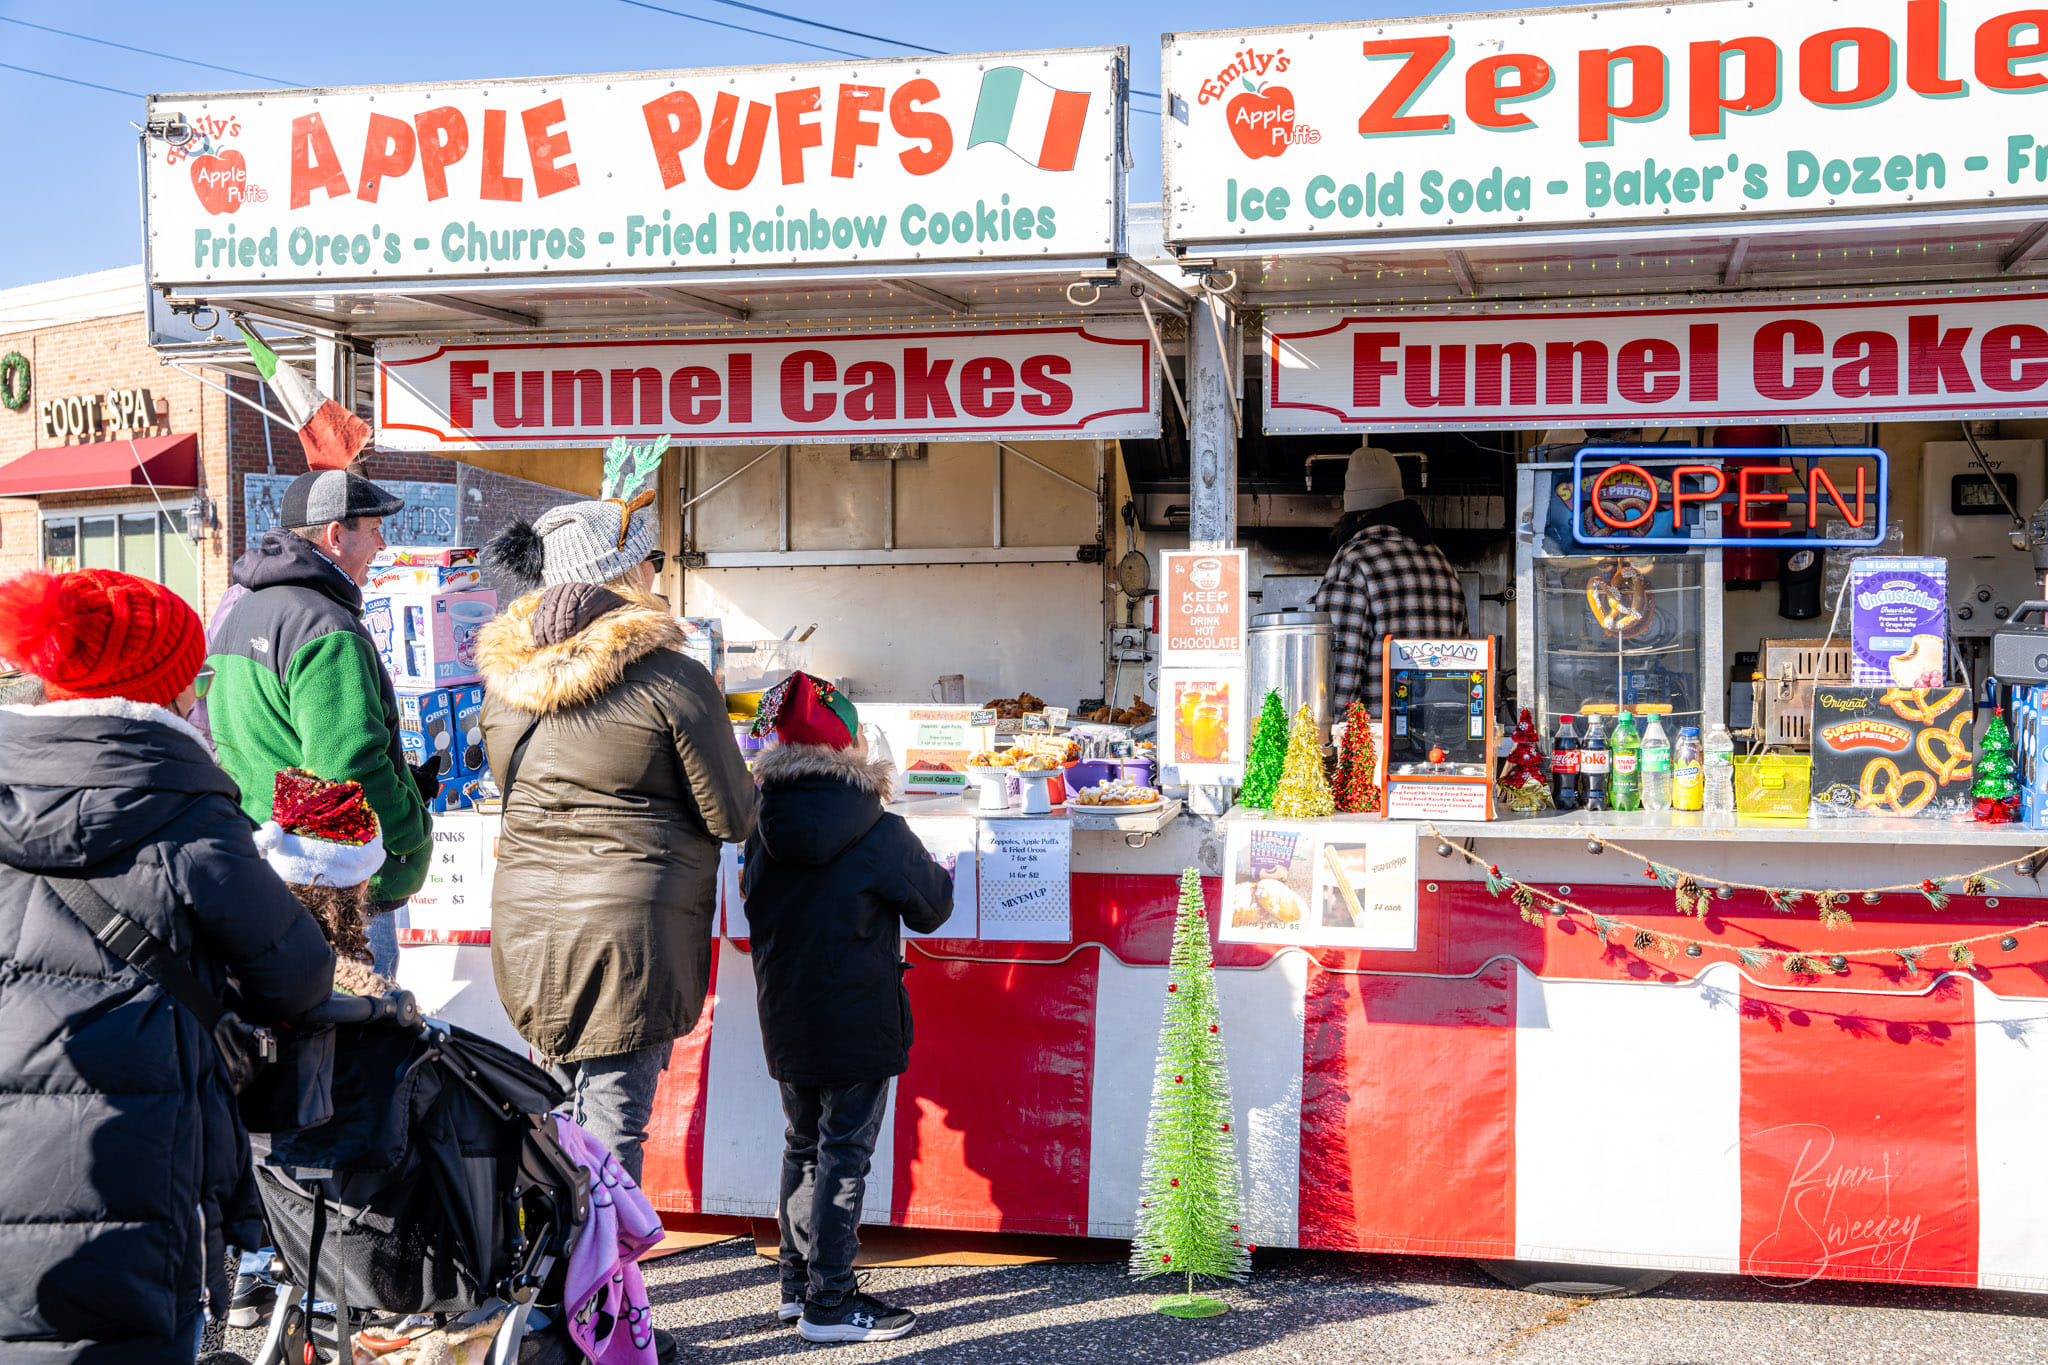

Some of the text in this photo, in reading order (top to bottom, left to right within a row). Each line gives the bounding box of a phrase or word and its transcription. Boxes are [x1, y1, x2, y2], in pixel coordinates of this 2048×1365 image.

[1198, 48, 1291, 106] Emily's
[1235, 106, 1295, 129] Apple
[1272, 125, 1321, 146] Puffs
[290, 78, 954, 210] APPLE PUFFS
[198, 166, 247, 188] Apple
[228, 184, 268, 203] Puffs
[1227, 178, 1291, 222] Ice
[1305, 171, 1404, 219] Cold
[1420, 167, 1531, 215] Soda
[1585, 153, 1768, 208] Baker's
[1787, 150, 1946, 197] Dozen
[194, 223, 278, 269] Fried
[288, 224, 401, 266] Oreo's
[442, 222, 586, 263] Churros
[627, 209, 717, 257] Fried
[730, 205, 887, 254] Rainbow
[900, 193, 1056, 246] Cookies
[1353, 314, 2048, 407] Funnel Cake
[449, 346, 1073, 429] Funnel Cakes
[40, 388, 150, 438] FOOT SPA
[1592, 464, 1865, 529] OPEN
[372, 573, 400, 589] Twinkies
[1182, 591, 1228, 602] KEEP
[1858, 589, 1939, 611] Uncrustables
[1181, 603, 1229, 614] CALM
[1190, 616, 1220, 626] DRINK
[1195, 626, 1216, 636] HOT
[1171, 637, 1238, 649] CHOCOLATE
[405, 701, 415, 709] 12
[1820, 694, 1868, 712] Original
[425, 708, 449, 723] OREO
[1822, 720, 1911, 742] SUPERPRETZEL
[1839, 732, 1897, 743] SOFT PRETZELS
[1643, 750, 1671, 762] Sprite
[1817, 792, 1831, 803] 20
[432, 832, 465, 842] RINKS
[1022, 838, 1040, 846] Apple
[442, 853, 455, 864] $4
[430, 874, 463, 884] Tea $4
[409, 895, 438, 905] Water
[1034, 887, 1047, 899] UP
[1384, 903, 1402, 912] each
